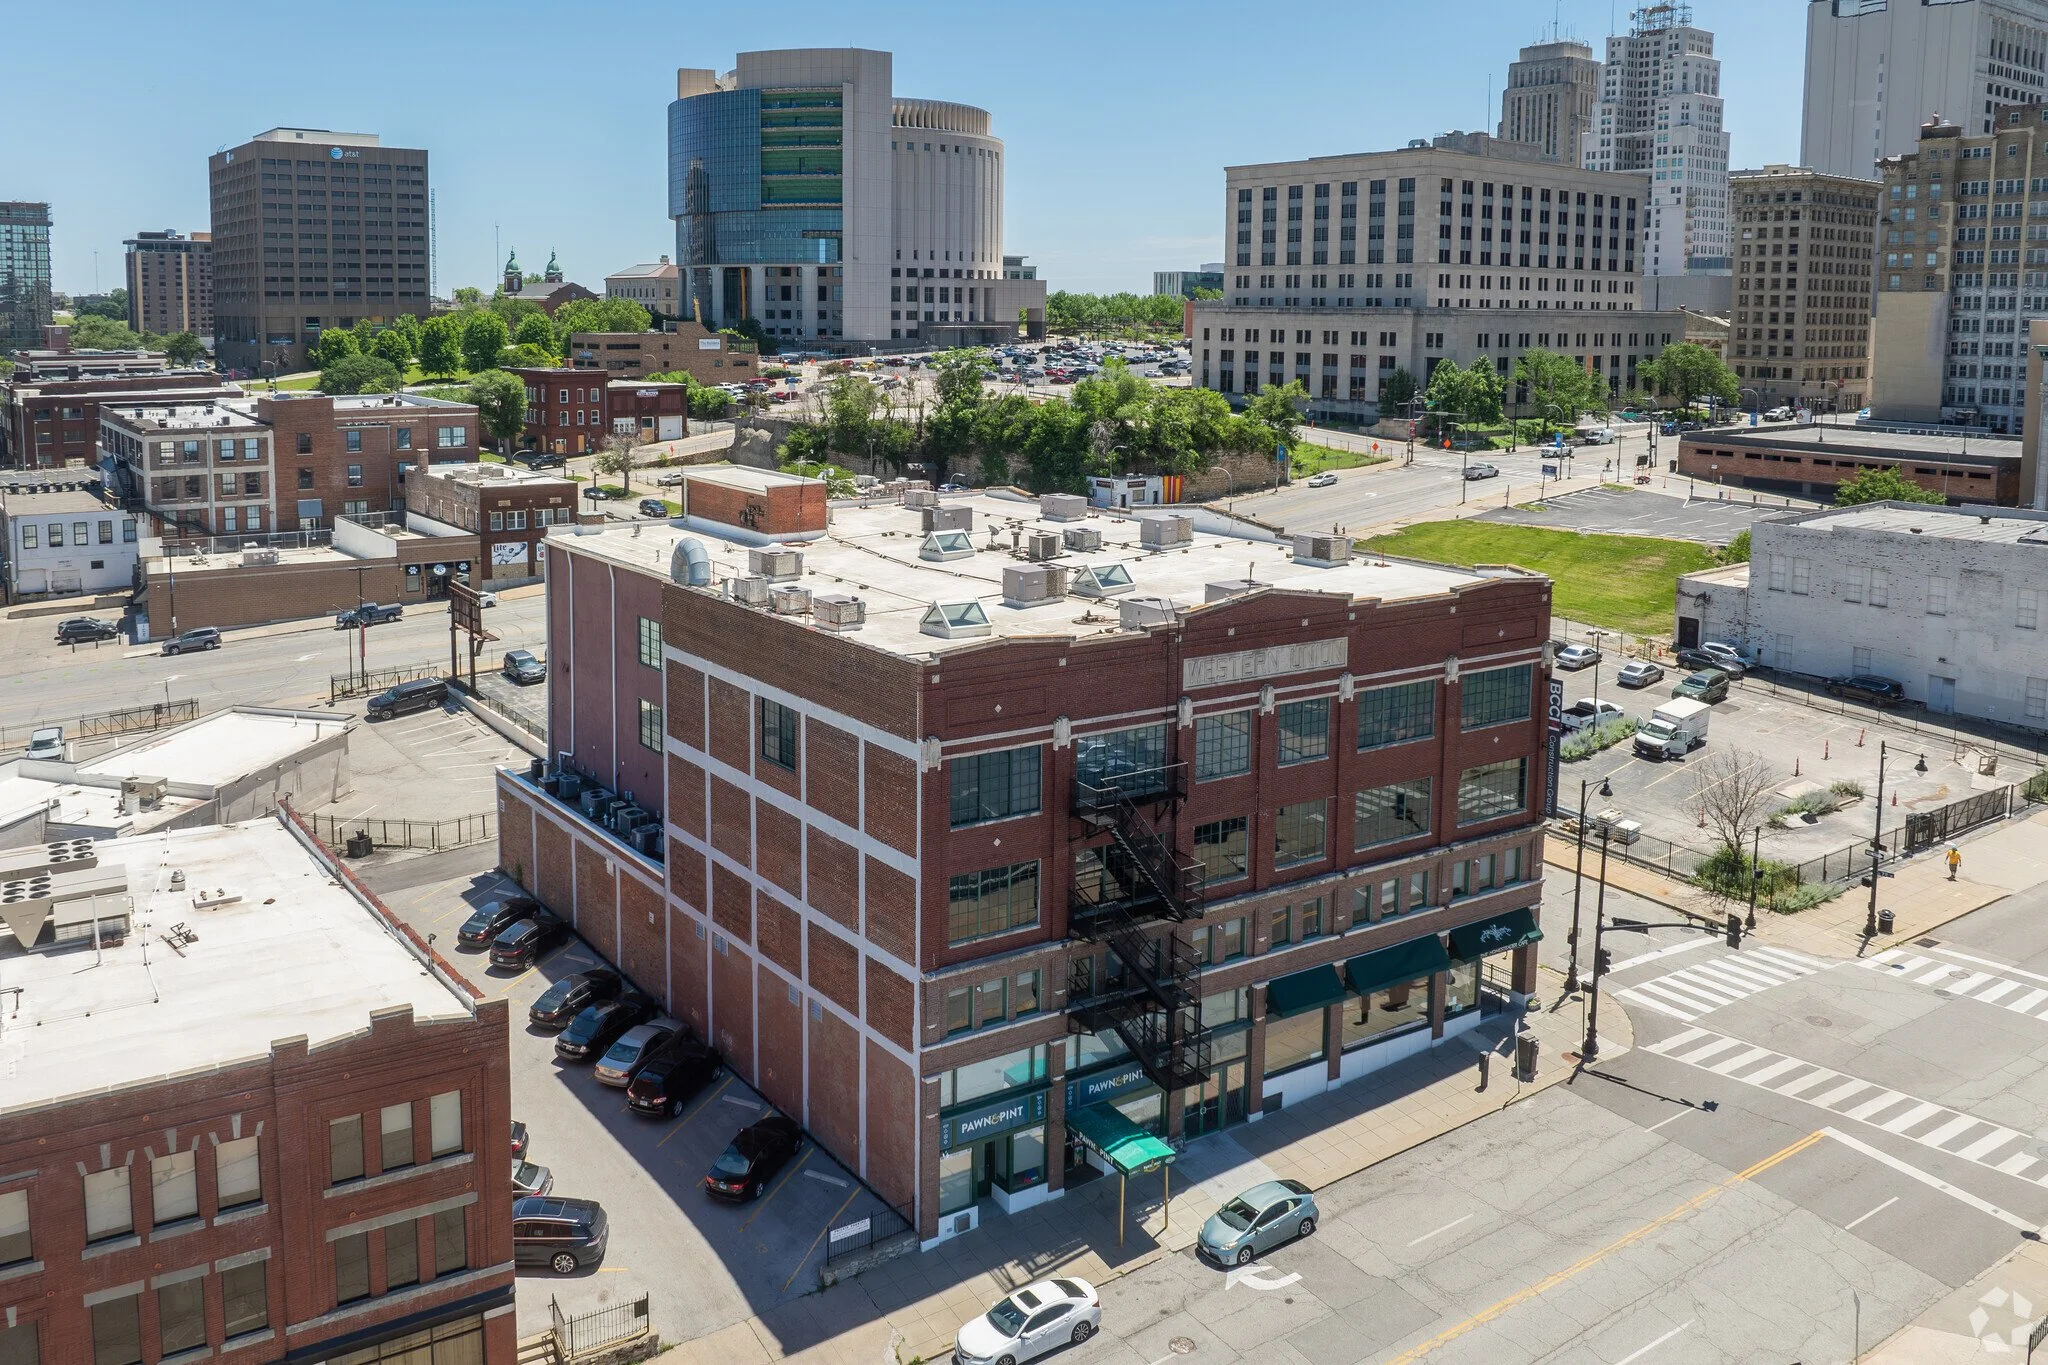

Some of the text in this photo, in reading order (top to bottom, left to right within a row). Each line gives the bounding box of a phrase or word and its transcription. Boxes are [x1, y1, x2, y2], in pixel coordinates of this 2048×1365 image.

[1188, 640, 1346, 685] WESTERN UNION
[1545, 735, 1557, 814] Construction Group
